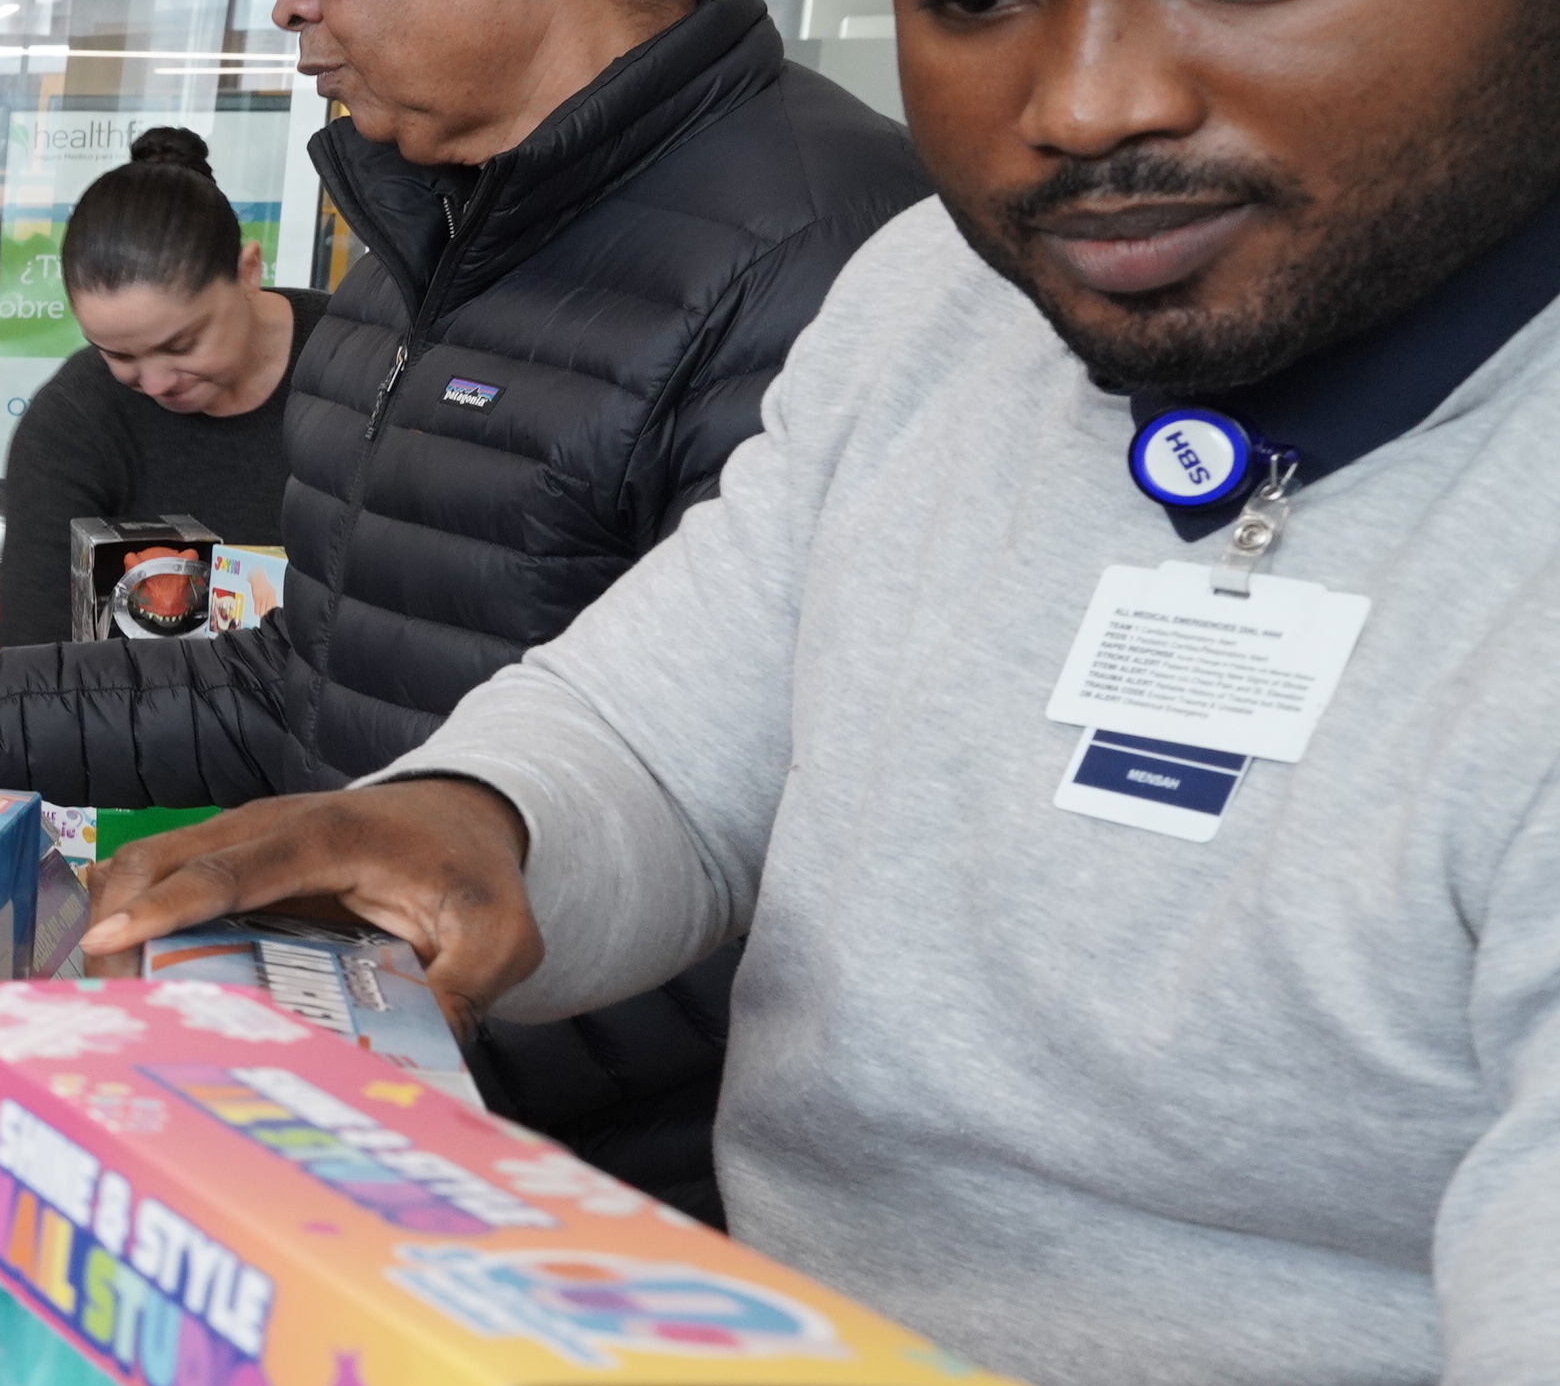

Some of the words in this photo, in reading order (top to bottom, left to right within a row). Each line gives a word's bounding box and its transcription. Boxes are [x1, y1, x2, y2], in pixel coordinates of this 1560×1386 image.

[443, 390, 488, 407] patagonia
[1165, 430, 1211, 486] SBH
[1126, 768, 1181, 791] MENSAH
[92, 1170, 132, 1256] &
[131, 1197, 274, 1357] STYLE
